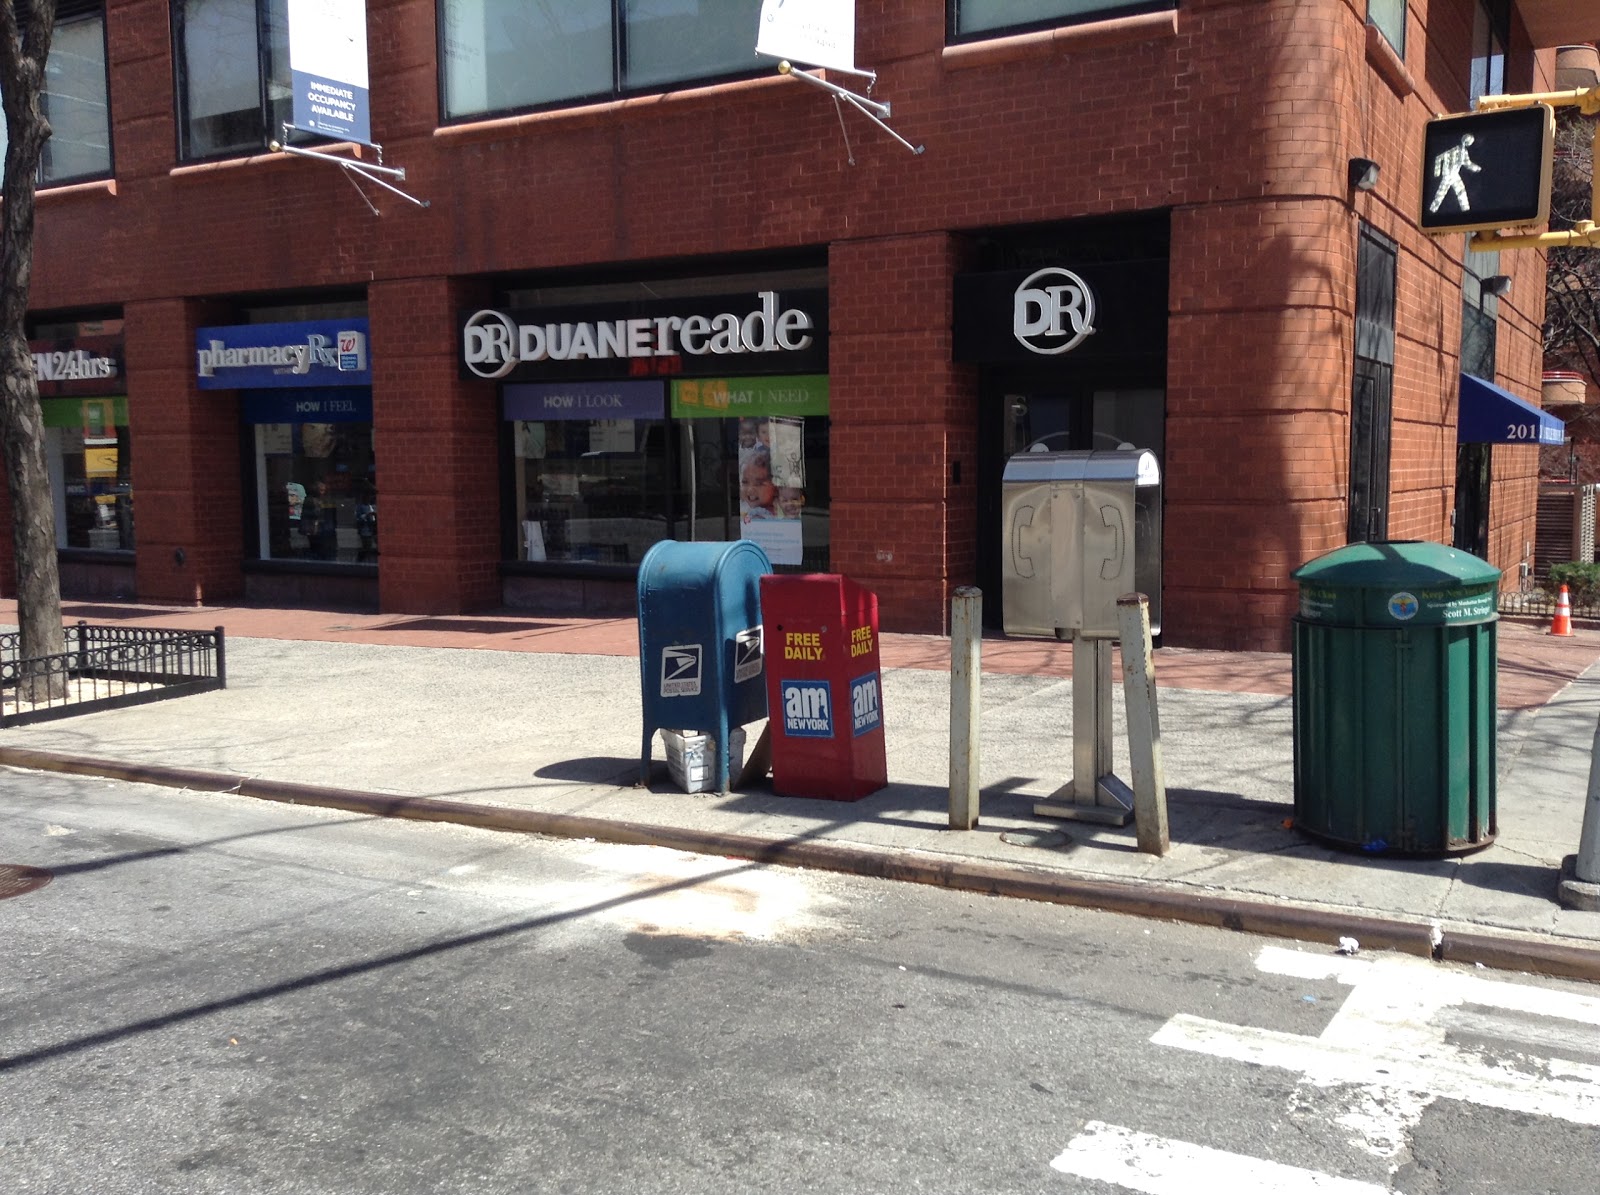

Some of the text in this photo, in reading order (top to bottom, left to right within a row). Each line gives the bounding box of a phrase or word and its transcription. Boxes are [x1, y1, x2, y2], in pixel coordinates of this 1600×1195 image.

[311, 81, 353, 100] IMMEDIATE
[308, 93, 356, 111] OCCUPANCY
[311, 104, 354, 122] AVAILABLE
[543, 395, 574, 409] HOW
[585, 394, 623, 408] LOOK
[712, 390, 754, 404] WHAT
[767, 388, 809, 403] NEED
[296, 401, 320, 413] HOW
[330, 400, 356, 412] FEEL
[1507, 424, 1536, 439] 201
[1442, 608, 1462, 618] Scott
[1463, 607, 1473, 617] M.
[785, 632, 821, 647] FREE
[851, 625, 872, 643] FREE
[784, 646, 823, 661] DAILY
[850, 638, 873, 658] DAILY
